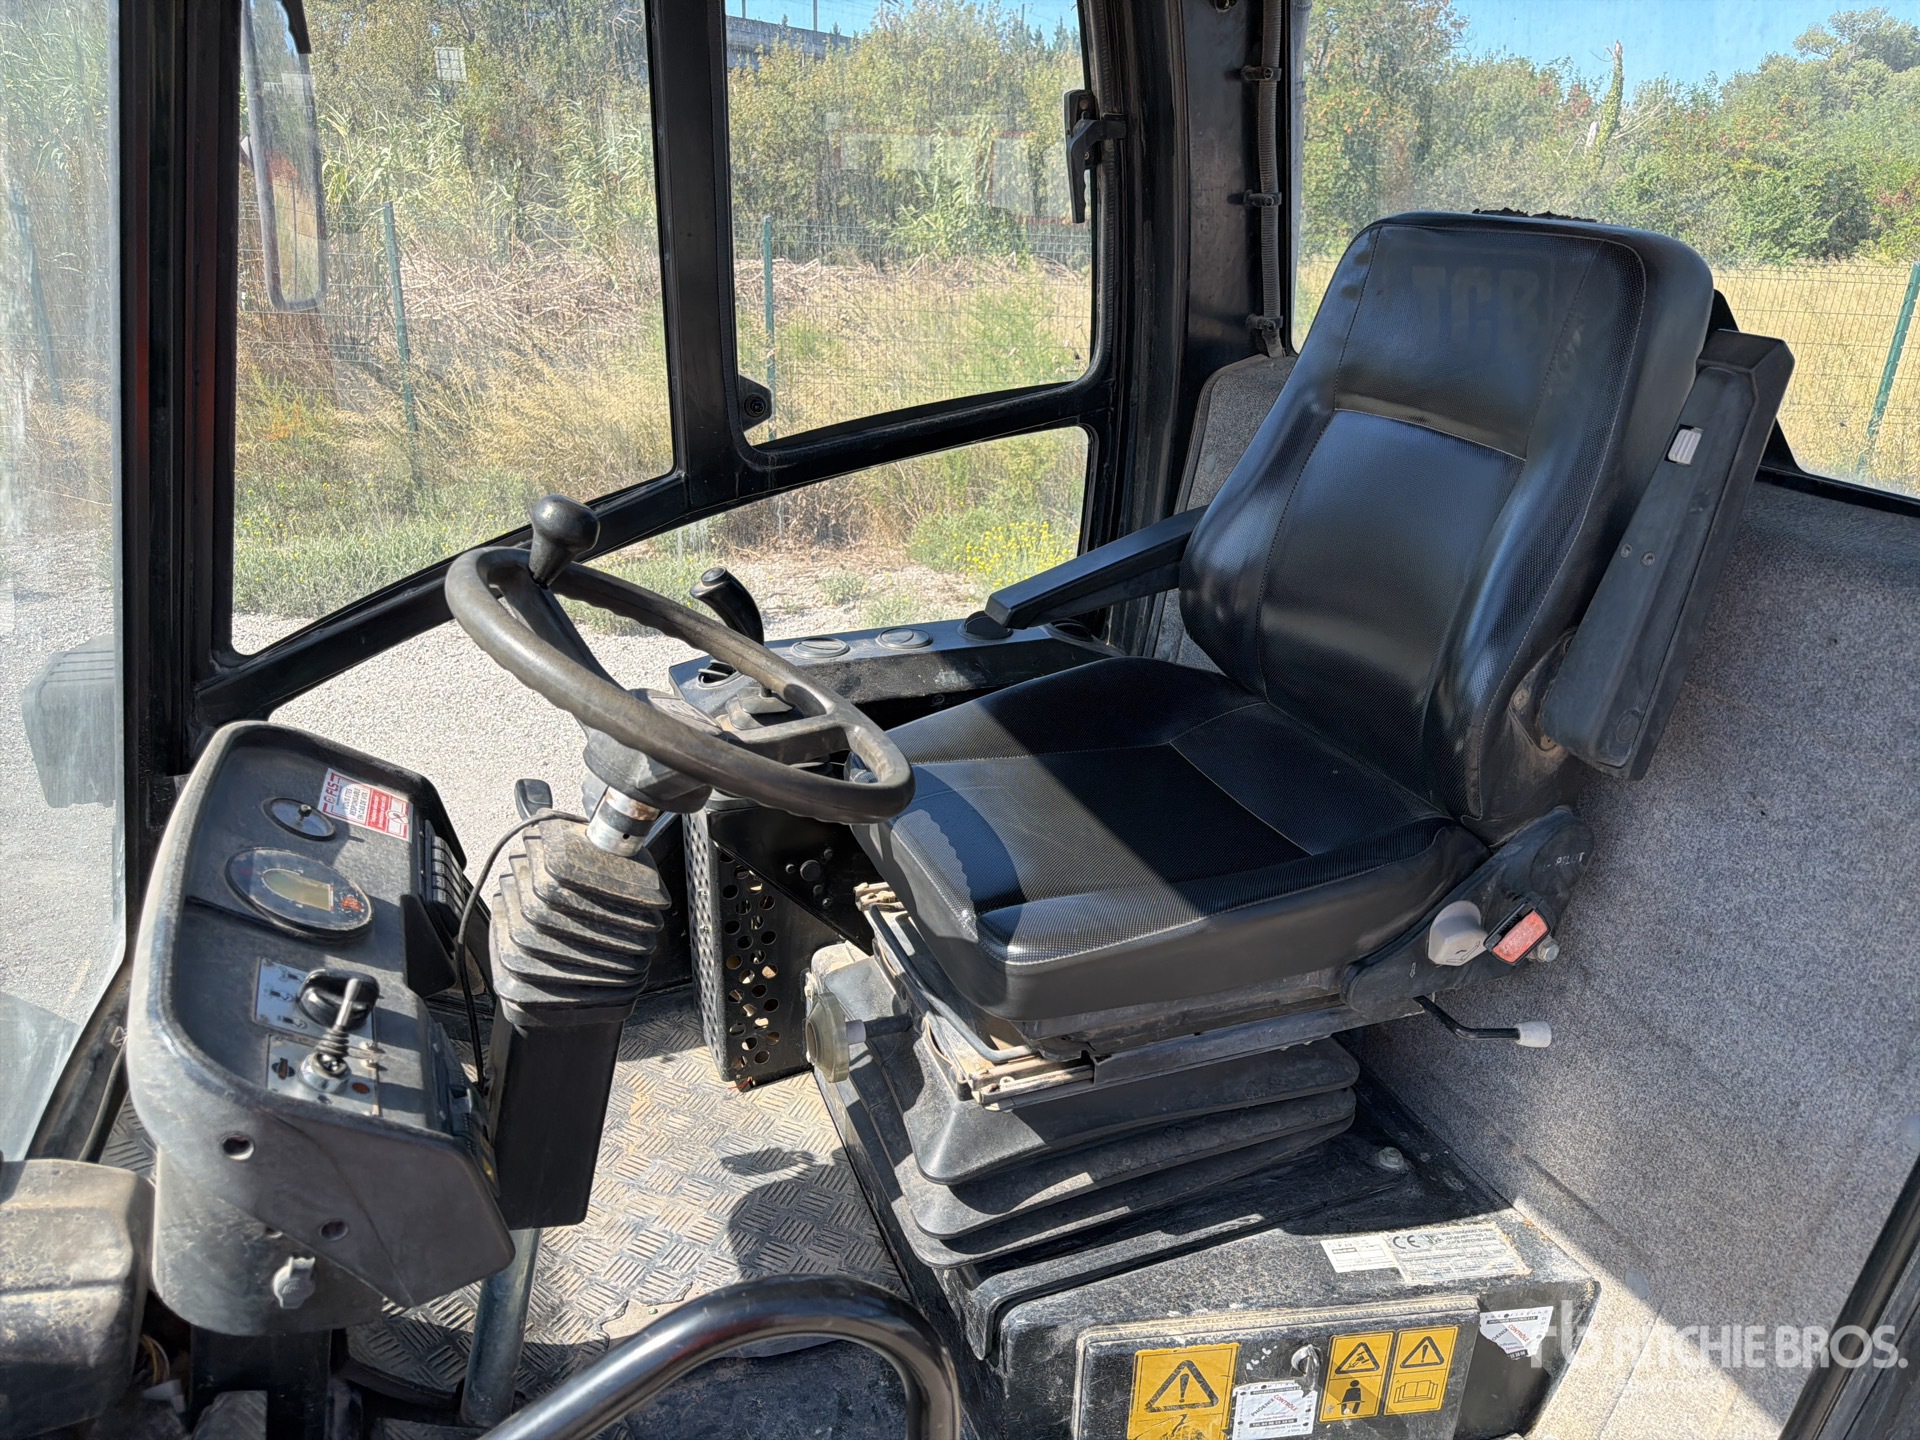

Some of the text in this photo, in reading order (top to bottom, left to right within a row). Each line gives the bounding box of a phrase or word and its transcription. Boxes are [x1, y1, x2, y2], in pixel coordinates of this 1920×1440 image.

[349, 787, 360, 815] RESPONSABLE
[1392, 1235, 1421, 1250] CE
[1492, 1328, 1508, 1340] OENIX
[1508, 1324, 1530, 1342] CONTRÔLE
[1251, 1394, 1298, 1416] PHOENIX CONTRÔLE
